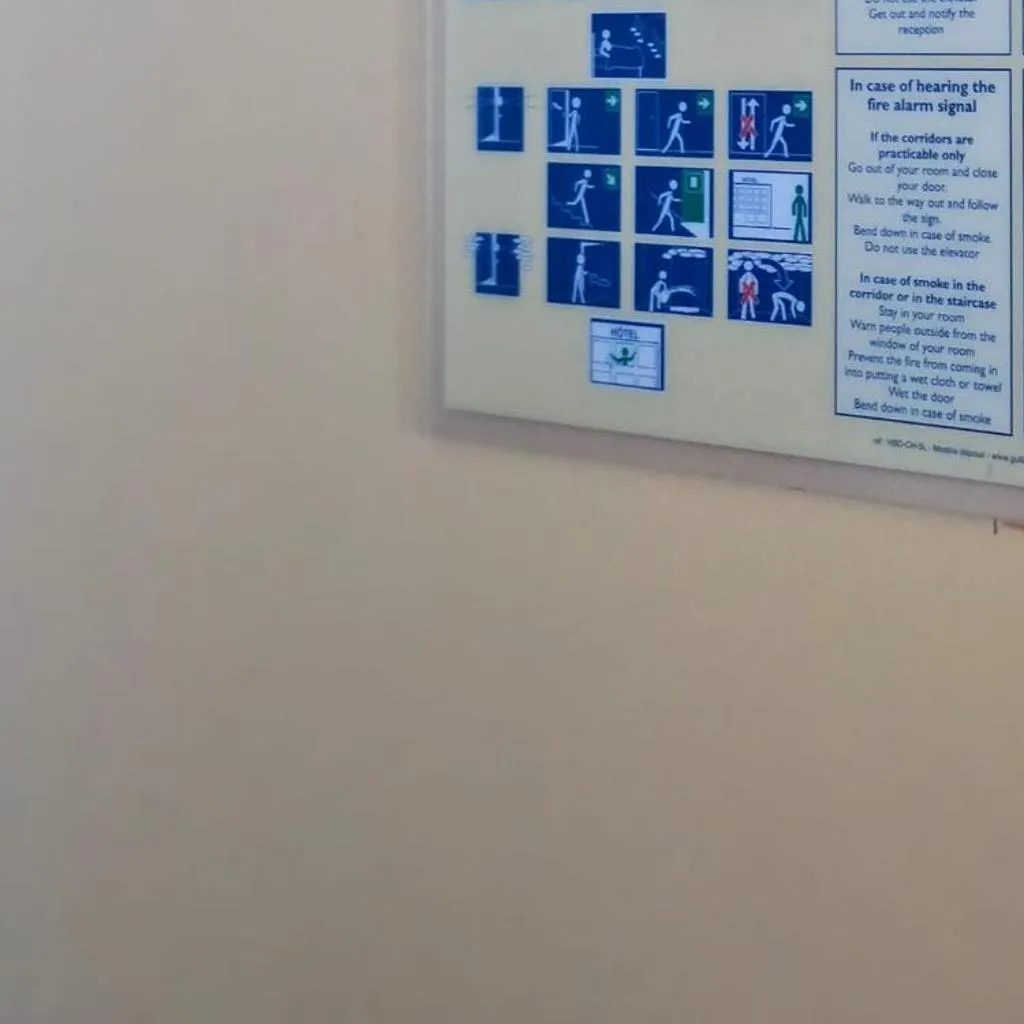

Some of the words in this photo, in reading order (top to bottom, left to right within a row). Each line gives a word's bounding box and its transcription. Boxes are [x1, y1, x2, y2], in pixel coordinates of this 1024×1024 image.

[849, 76, 863, 92] In
[866, 81, 896, 92] case
[898, 77, 913, 93] of
[915, 77, 968, 97] hearing
[971, 77, 996, 94] the
[866, 95, 890, 111] fire
[893, 95, 934, 112] alarm
[937, 96, 977, 116] signal
[879, 129, 900, 143] the
[899, 130, 952, 144] corridors
[954, 135, 974, 145] are
[877, 145, 939, 162] practicable
[940, 147, 966, 164] only
